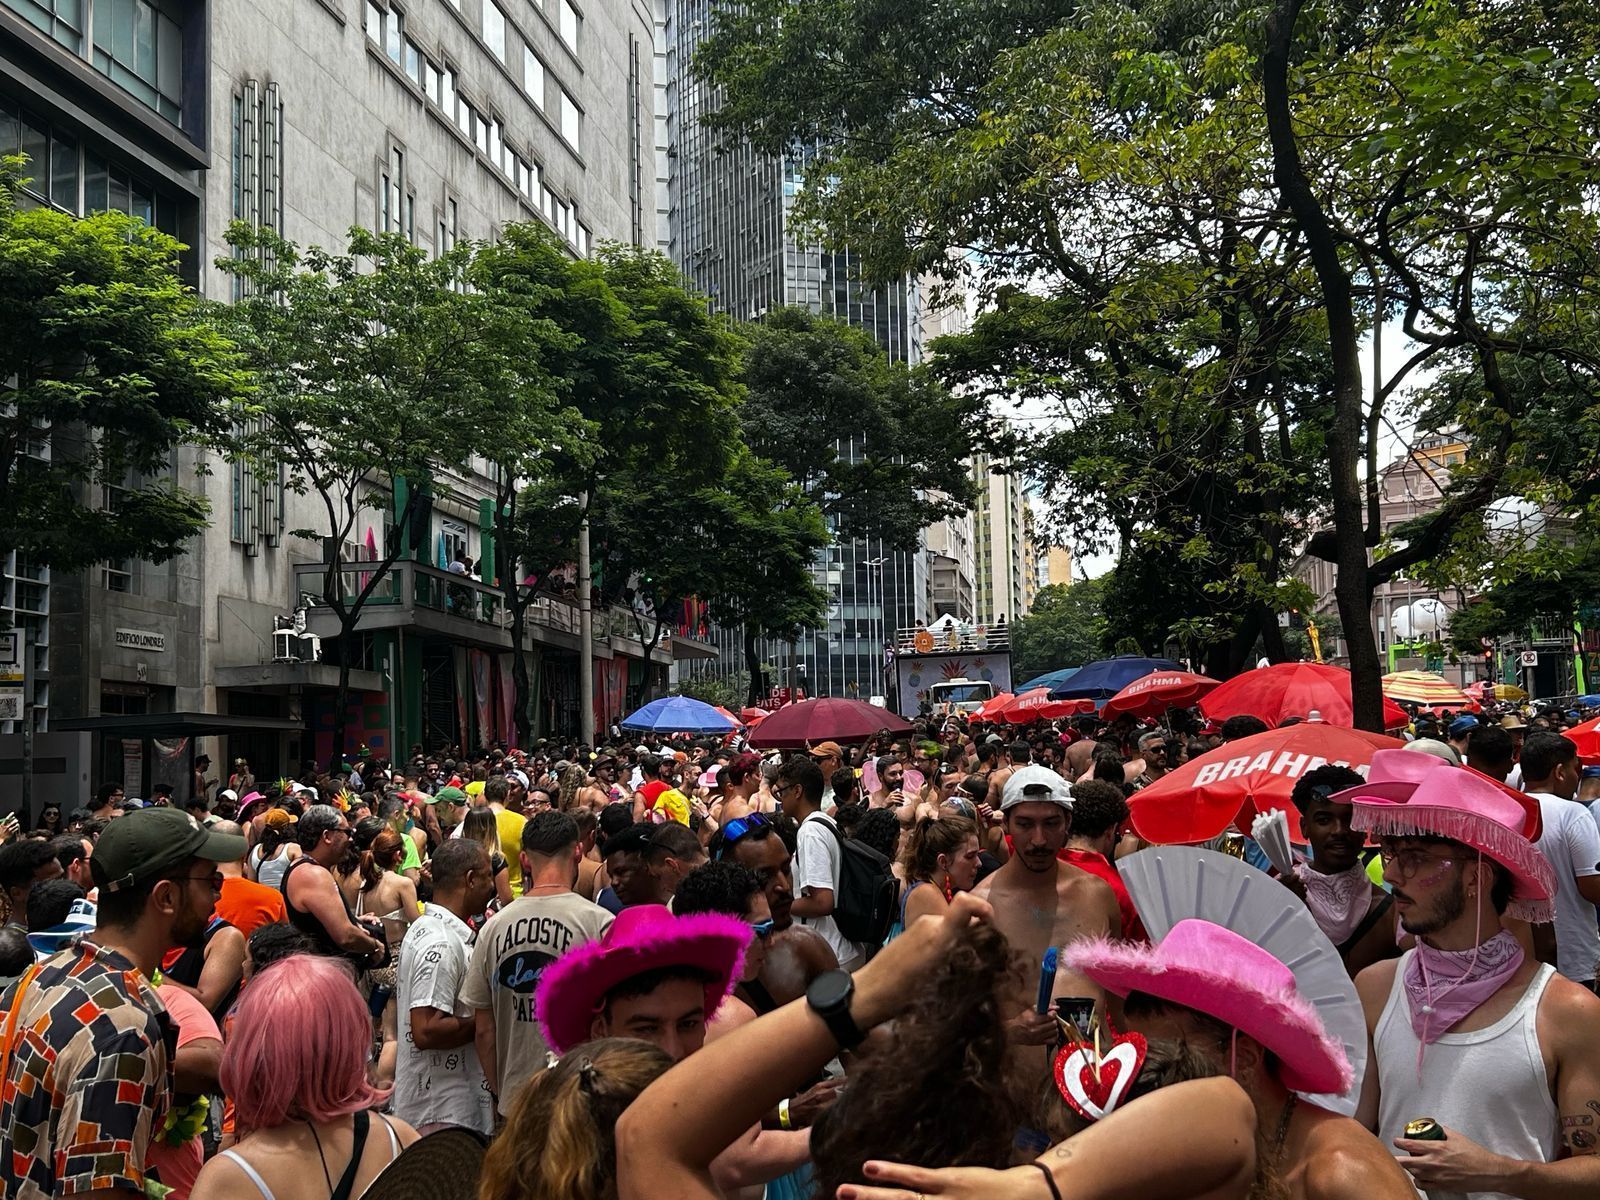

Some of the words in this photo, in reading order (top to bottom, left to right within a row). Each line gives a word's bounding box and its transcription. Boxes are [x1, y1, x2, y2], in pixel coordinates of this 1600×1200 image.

[116, 632, 140, 645] EDIFICIO
[140, 635, 165, 648] LONDRES
[1128, 677, 1182, 694] BRAHMA
[1191, 750, 1371, 788] BRAH
[495, 917, 573, 964] LACOSTE
[512, 995, 538, 1022] PAR
